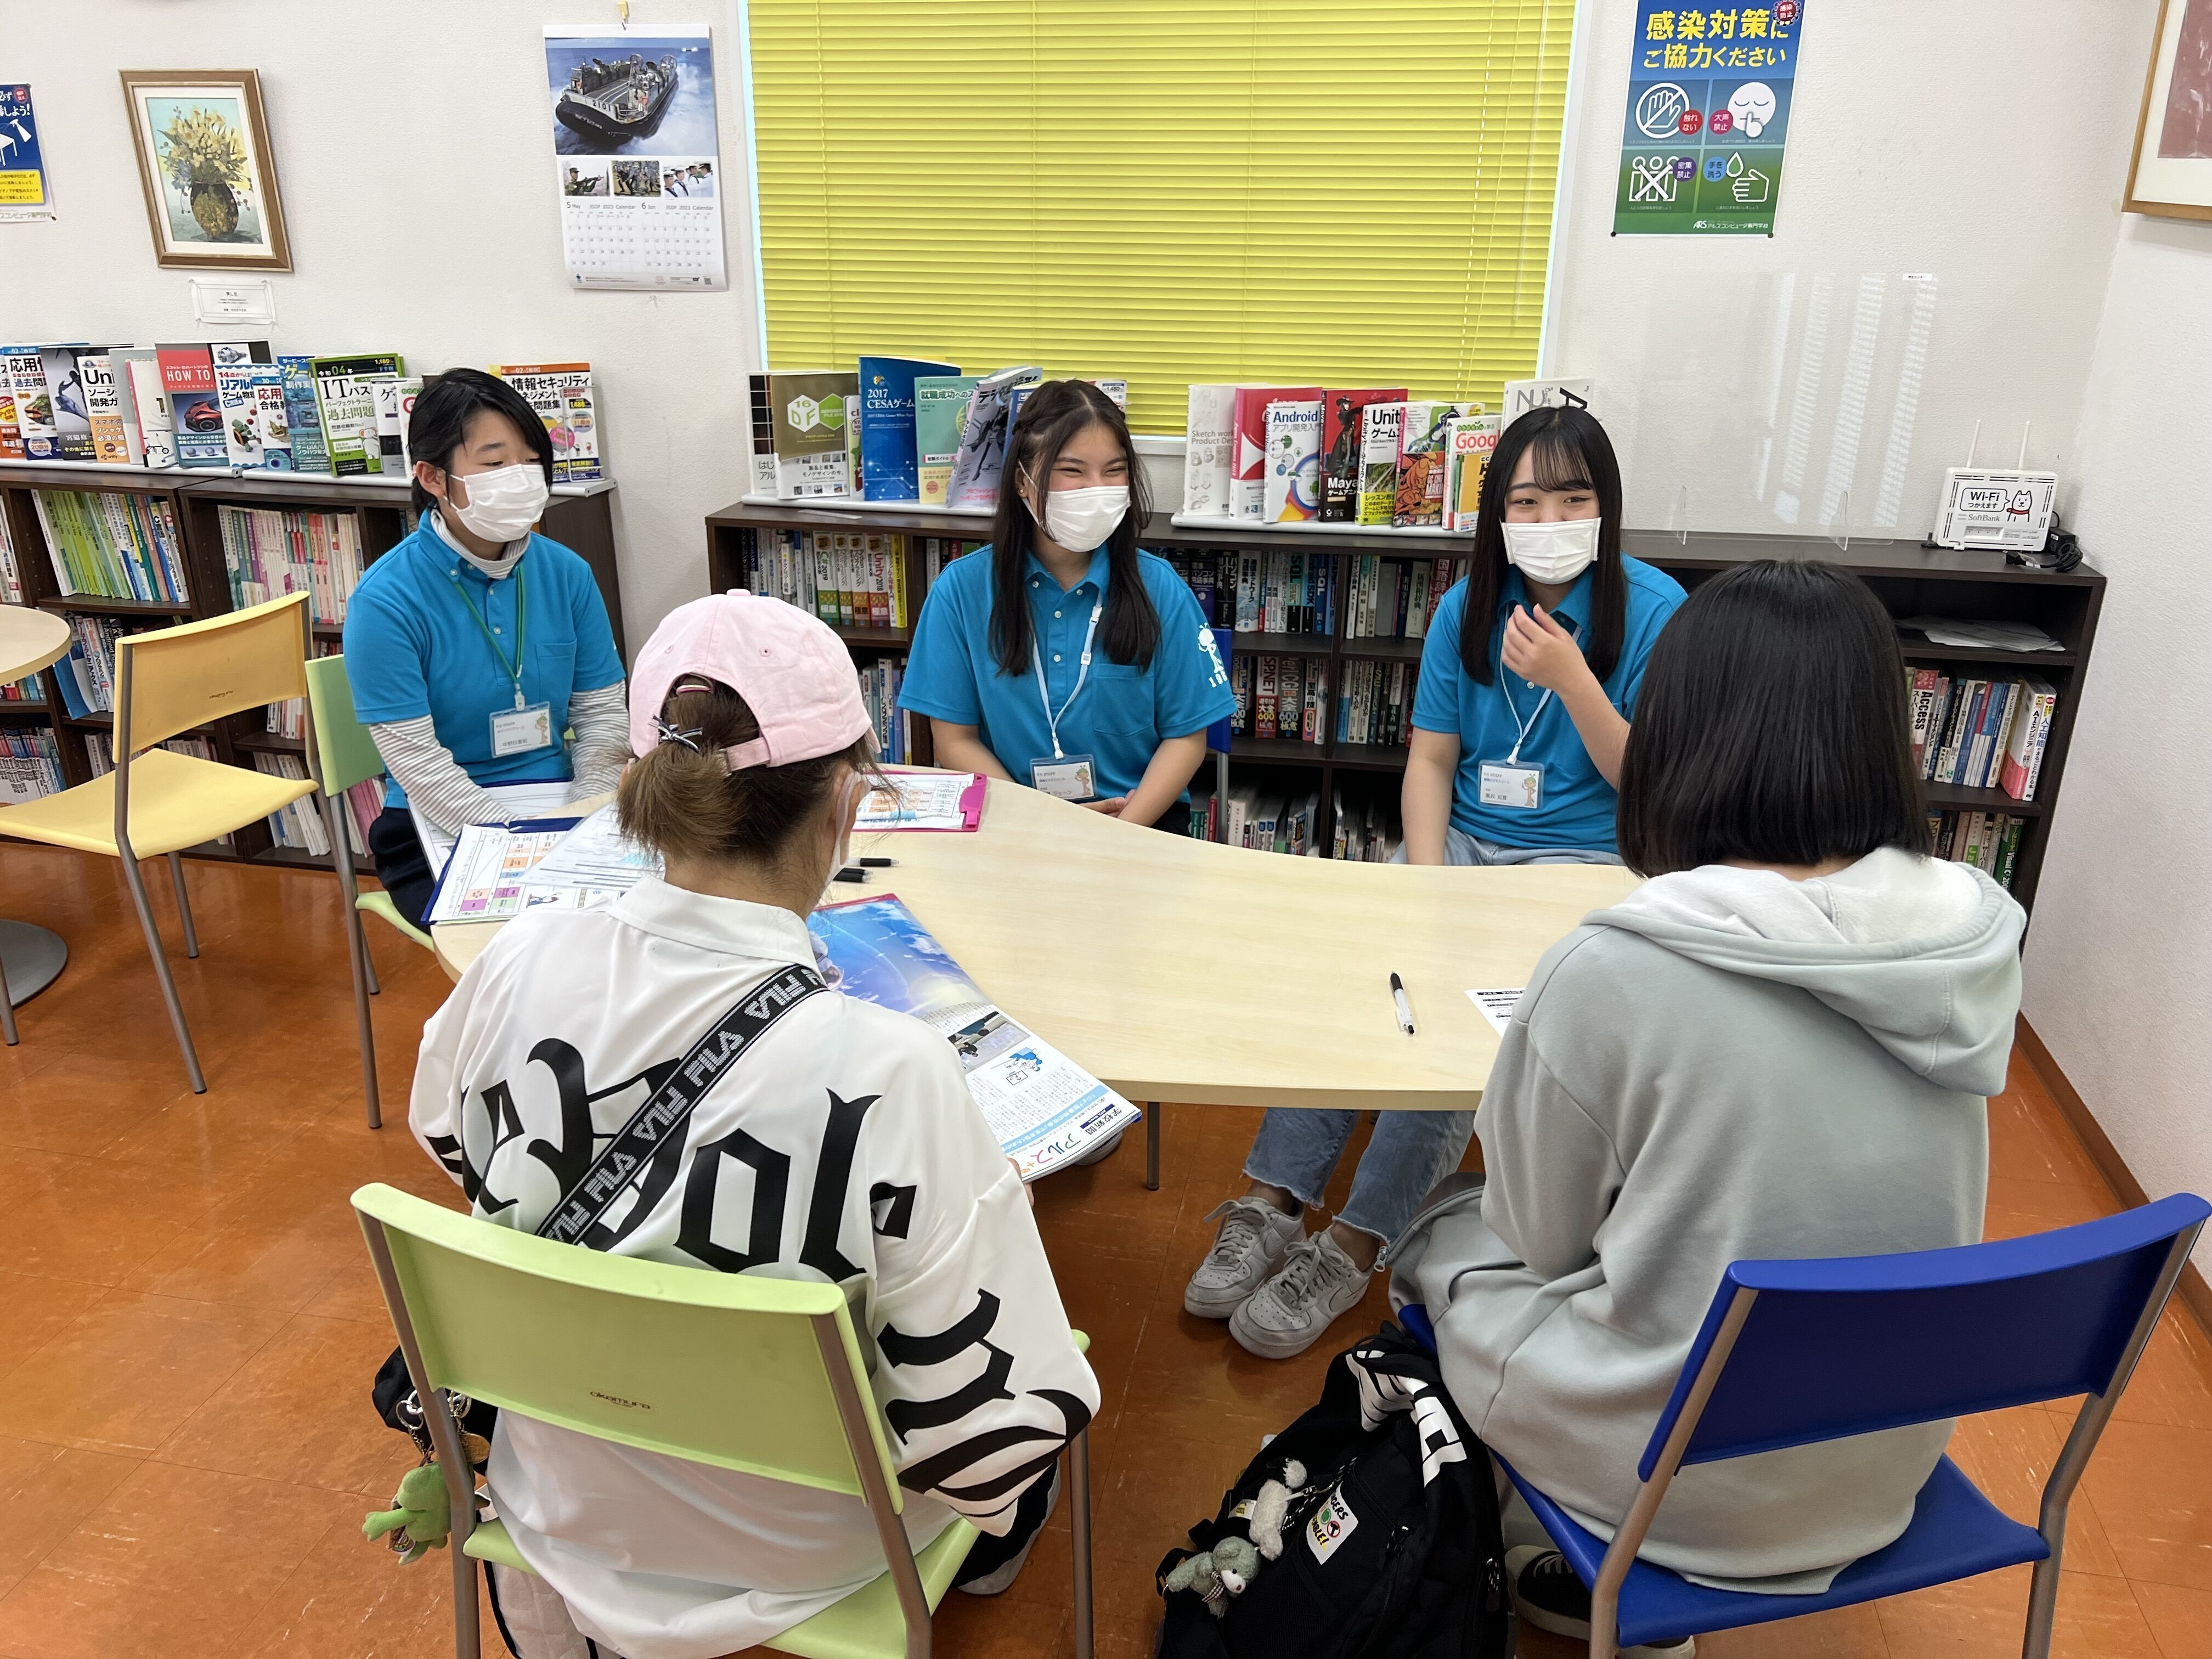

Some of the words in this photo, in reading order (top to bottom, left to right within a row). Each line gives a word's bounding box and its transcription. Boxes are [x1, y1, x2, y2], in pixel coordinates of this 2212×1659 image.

[1646, 9, 1790, 40] 感染対策に
[1643, 43, 1786, 69] ご協力ください
[1683, 114, 1698, 122] 触れ
[1714, 114, 1729, 122] 大声
[10, 357, 43, 373] 応用
[167, 370, 195, 382] HOW
[196, 370, 210, 381] TO
[511, 376, 589, 391] 情報セキュリティ
[220, 380, 252, 390] リアル
[258, 388, 283, 400] 応用
[867, 390, 888, 398] 2017
[1273, 410, 1317, 422] Android
[1328, 477, 1357, 489] Maya
[1971, 492, 2000, 501] Wi-Fi
[1317, 568, 1326, 596] SQL
[1915, 691, 1933, 730] Access
[744, 973, 806, 1019] FILA
[684, 1030, 744, 1087] FILA
[632, 1086, 688, 1141] FILA
[1085, 1108, 1123, 1136] 学校新聞
[1030, 1133, 1081, 1164] アルス
[584, 1152, 637, 1203] FILA
